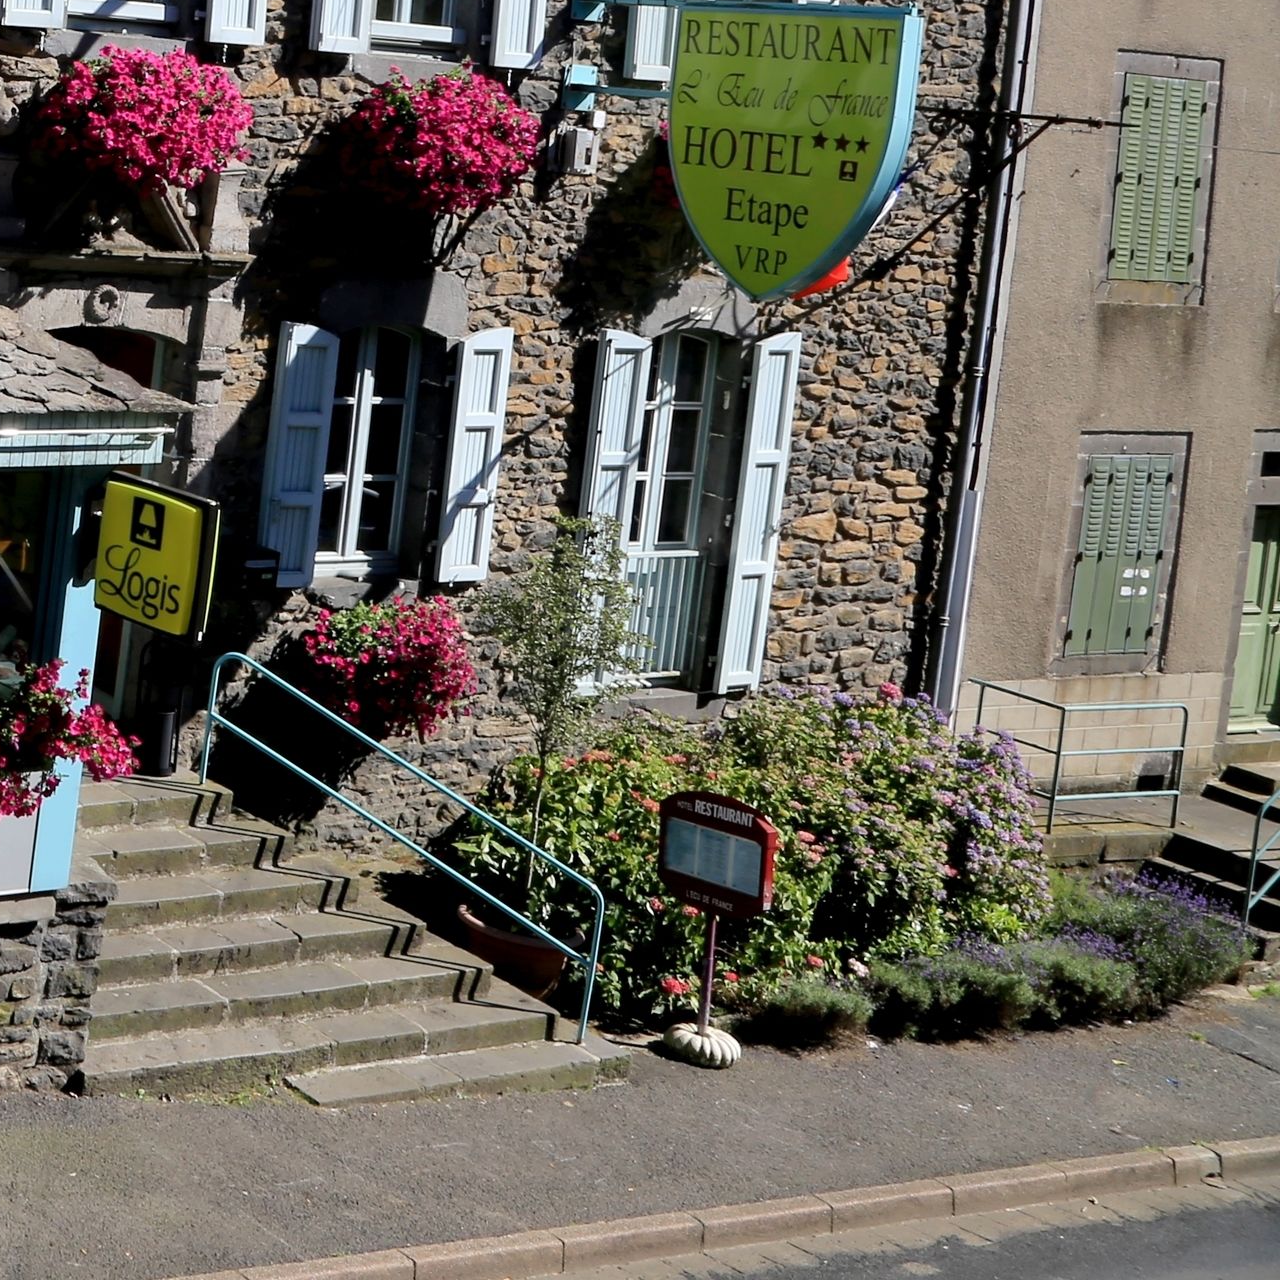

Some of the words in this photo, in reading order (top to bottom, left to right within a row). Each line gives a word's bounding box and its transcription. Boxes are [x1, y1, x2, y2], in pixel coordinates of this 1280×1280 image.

[683, 19, 896, 65] RESTAURANT
[774, 78, 798, 112] de
[681, 126, 813, 177] HOTEL
[724, 187, 809, 237] Etape
[735, 244, 788, 276] VRP
[98, 544, 181, 620] Logis
[694, 800, 755, 828] RESTAURANT
